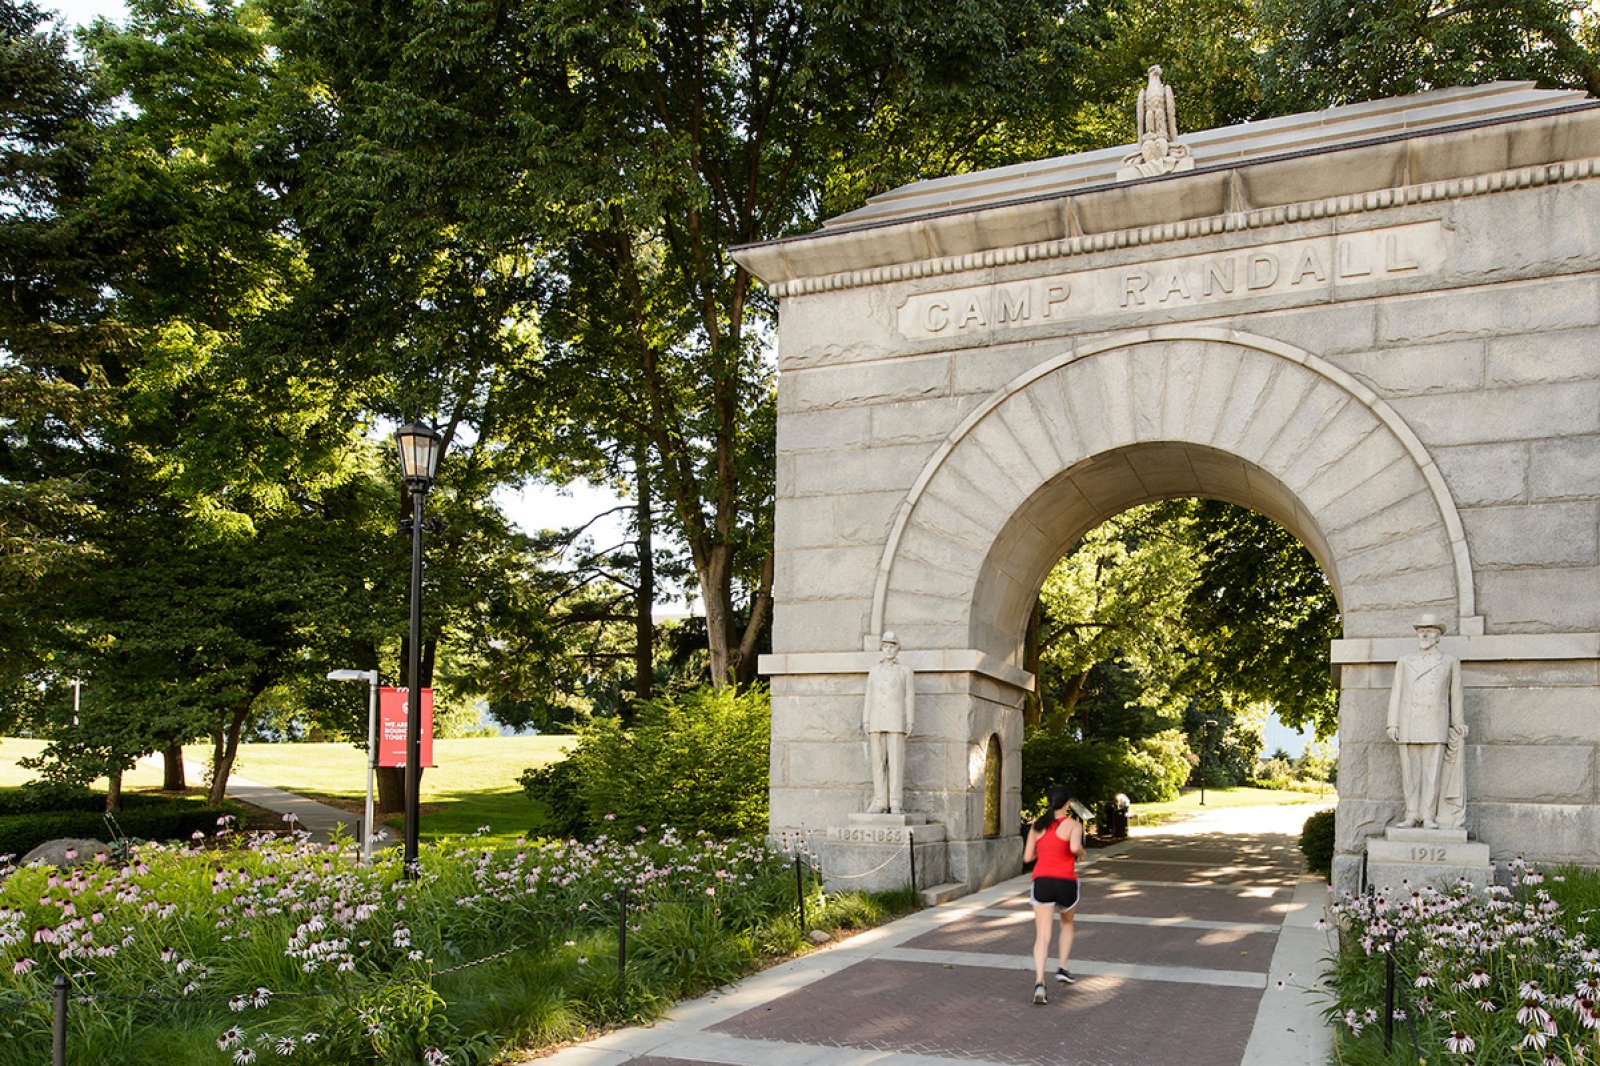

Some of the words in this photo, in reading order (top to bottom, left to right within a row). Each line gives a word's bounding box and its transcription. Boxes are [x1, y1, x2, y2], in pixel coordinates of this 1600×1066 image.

[923, 280, 1071, 332] CAMP
[1120, 234, 1418, 307] RANDALL
[838, 828, 902, 842] 1861-1865
[1411, 847, 1447, 861] 1912
